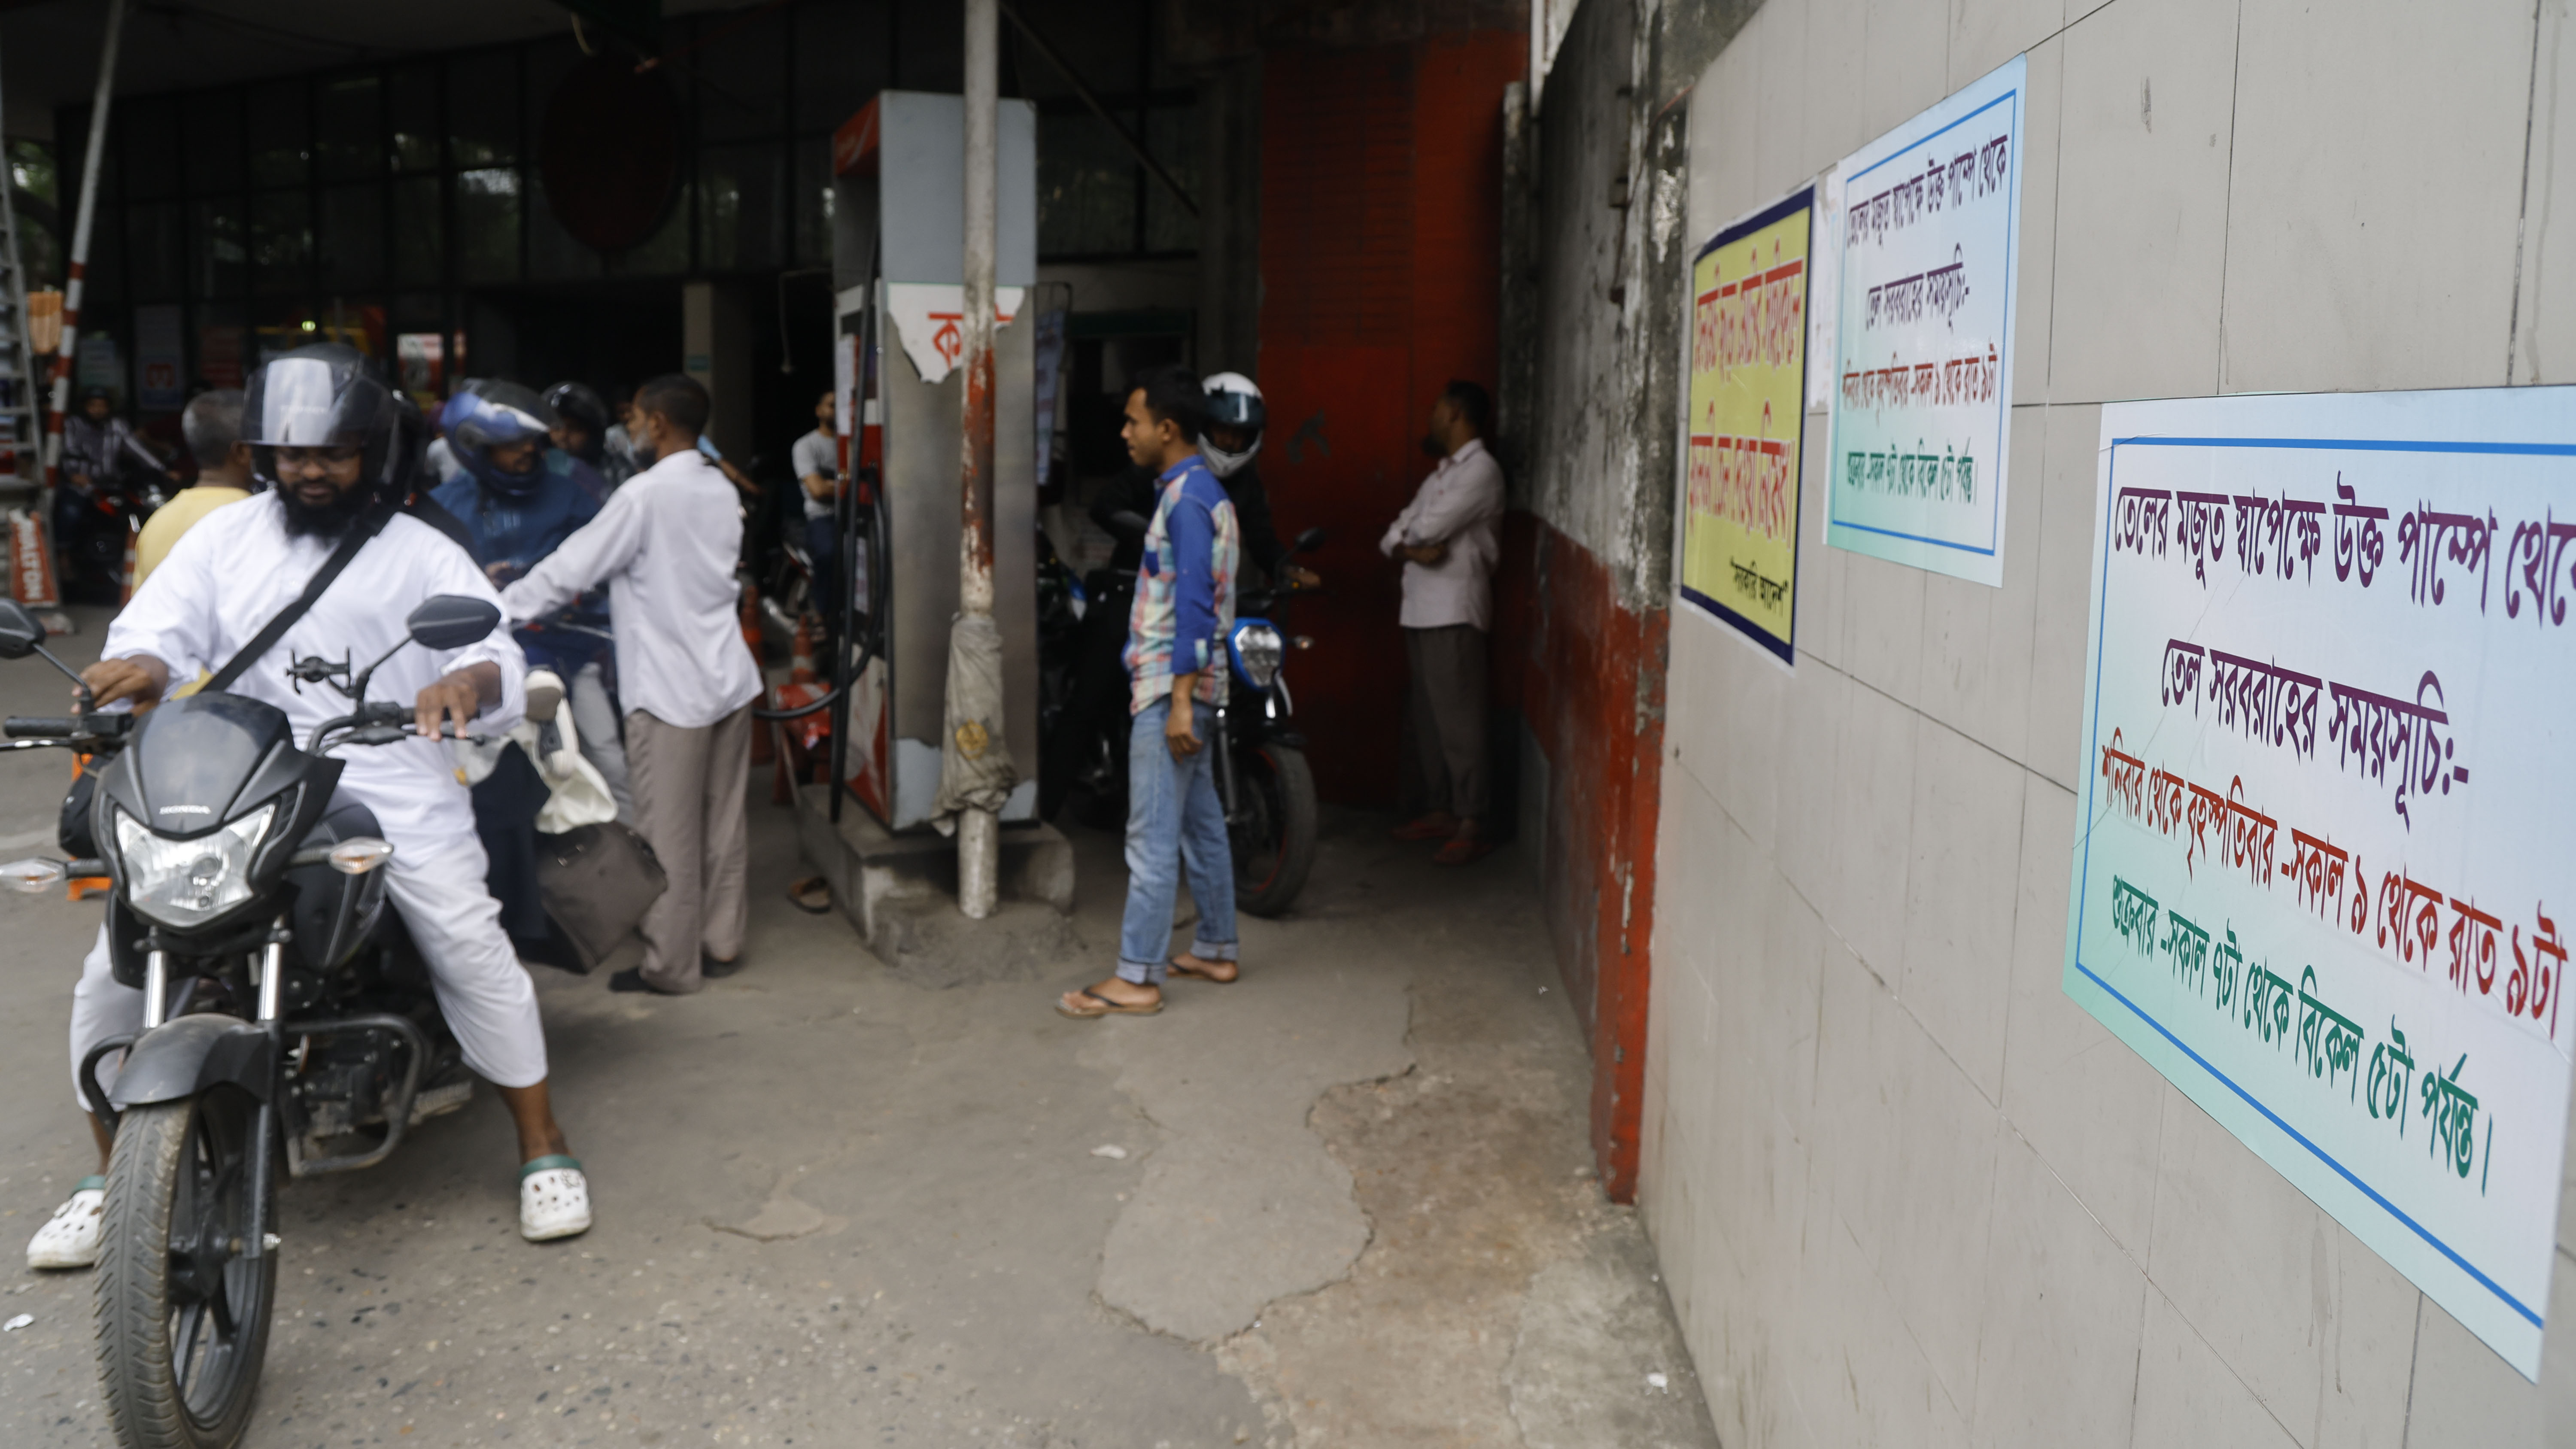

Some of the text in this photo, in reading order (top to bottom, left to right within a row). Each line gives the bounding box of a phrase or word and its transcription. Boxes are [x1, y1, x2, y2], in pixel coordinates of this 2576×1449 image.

[1847, 201, 1869, 248] তেলের
[1928, 152, 1945, 213] উক্ত
[1948, 144, 1977, 209] পাম্পে
[1980, 134, 2008, 198] থেকে
[1943, 354, 1962, 406] থেকে
[1964, 352, 1980, 406] রাত
[2116, 486, 2172, 562] তেলের
[2176, 491, 2229, 590] মজুত
[2233, 486, 2326, 587] স্বাপেক্ষে
[2333, 470, 2389, 588] উক্ত
[2398, 497, 2498, 617] পাম্পে
[2162, 638, 2205, 720] তেল
[2210, 649, 2323, 766] সরবরাহের
[159, 805, 211, 815] HONDA
[2102, 726, 2146, 823] শনিবার
[2147, 762, 2184, 841] থেকে
[2187, 775, 2278, 892] বৃহস্পতিবার
[2351, 855, 2367, 934] ৯
[2378, 862, 2444, 972] থেকে
[2449, 896, 2503, 996] রাত
[2507, 899, 2567, 1041] ৯টা
[2113, 874, 2159, 962] শুক্রবার
[2212, 917, 2243, 1023] ৭টা
[2245, 956, 2294, 1053] থেকে
[2295, 964, 2364, 1107] বিকেল
[2367, 1014, 2415, 1140] ৫টা
